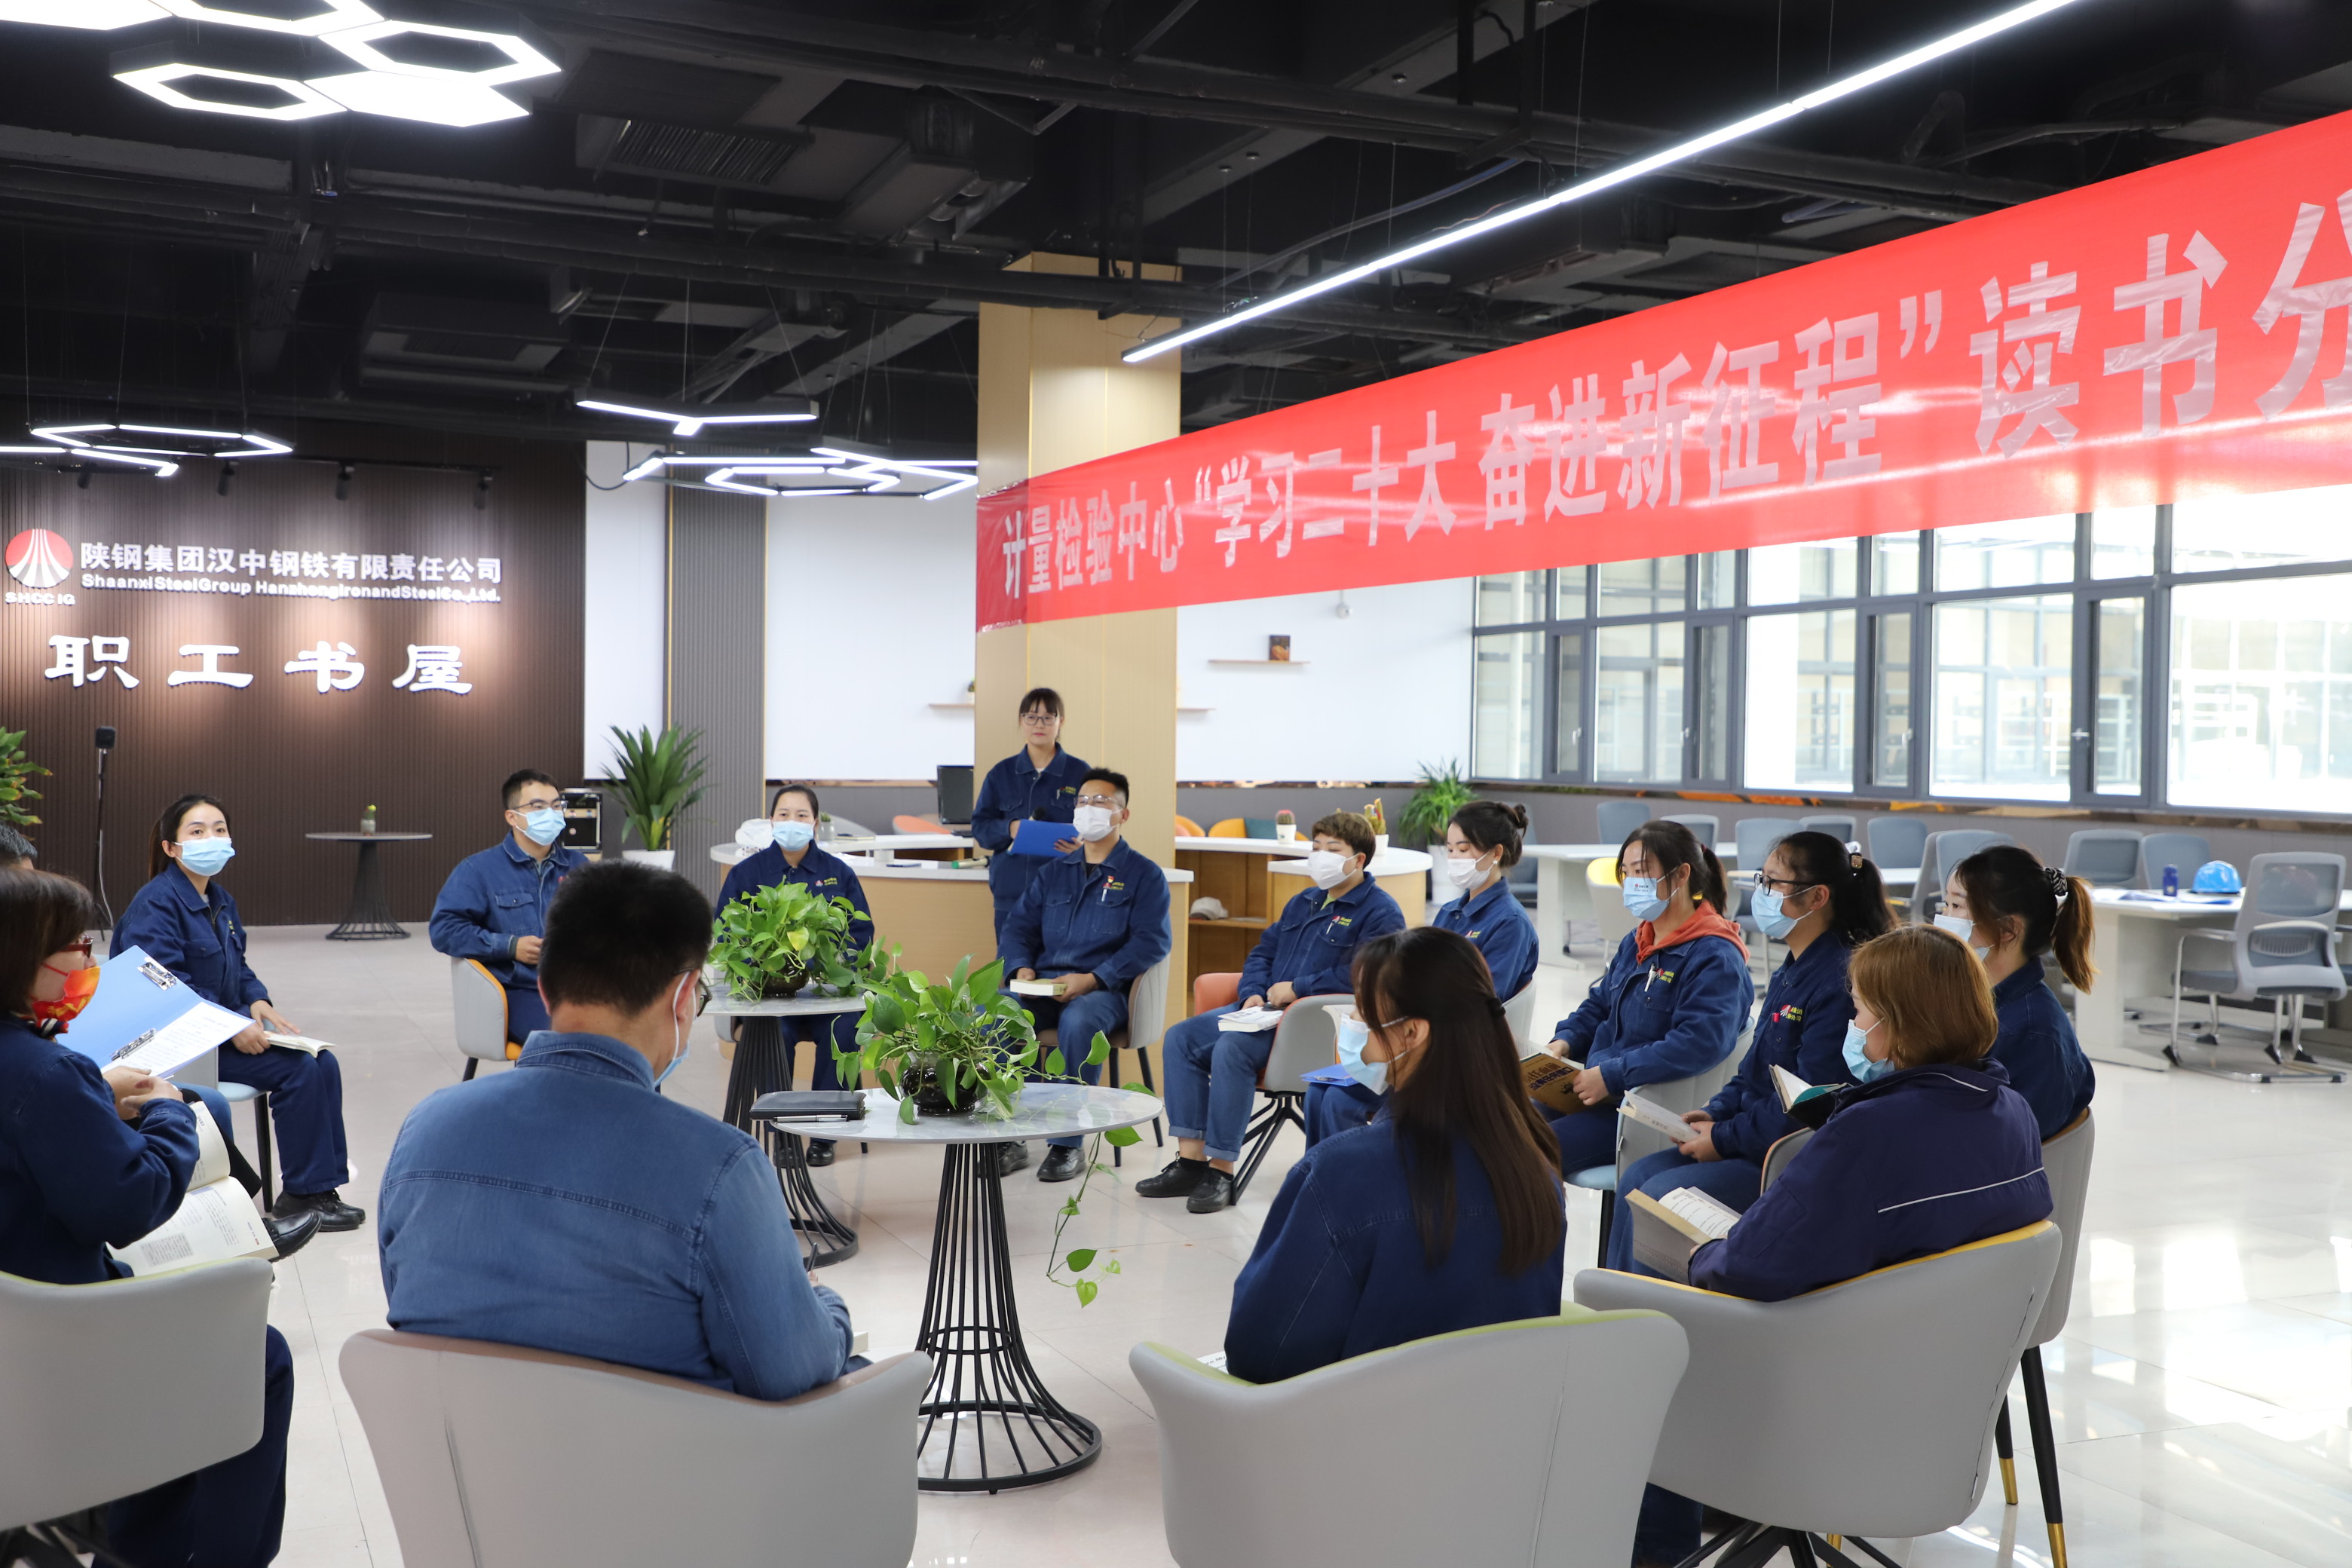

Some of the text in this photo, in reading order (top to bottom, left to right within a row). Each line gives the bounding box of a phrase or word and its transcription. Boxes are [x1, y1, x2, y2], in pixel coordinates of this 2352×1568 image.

[81, 542, 502, 584] 陕钢集团汉中钢铁有限责任公司
[44, 634, 473, 695] 职工书屋
